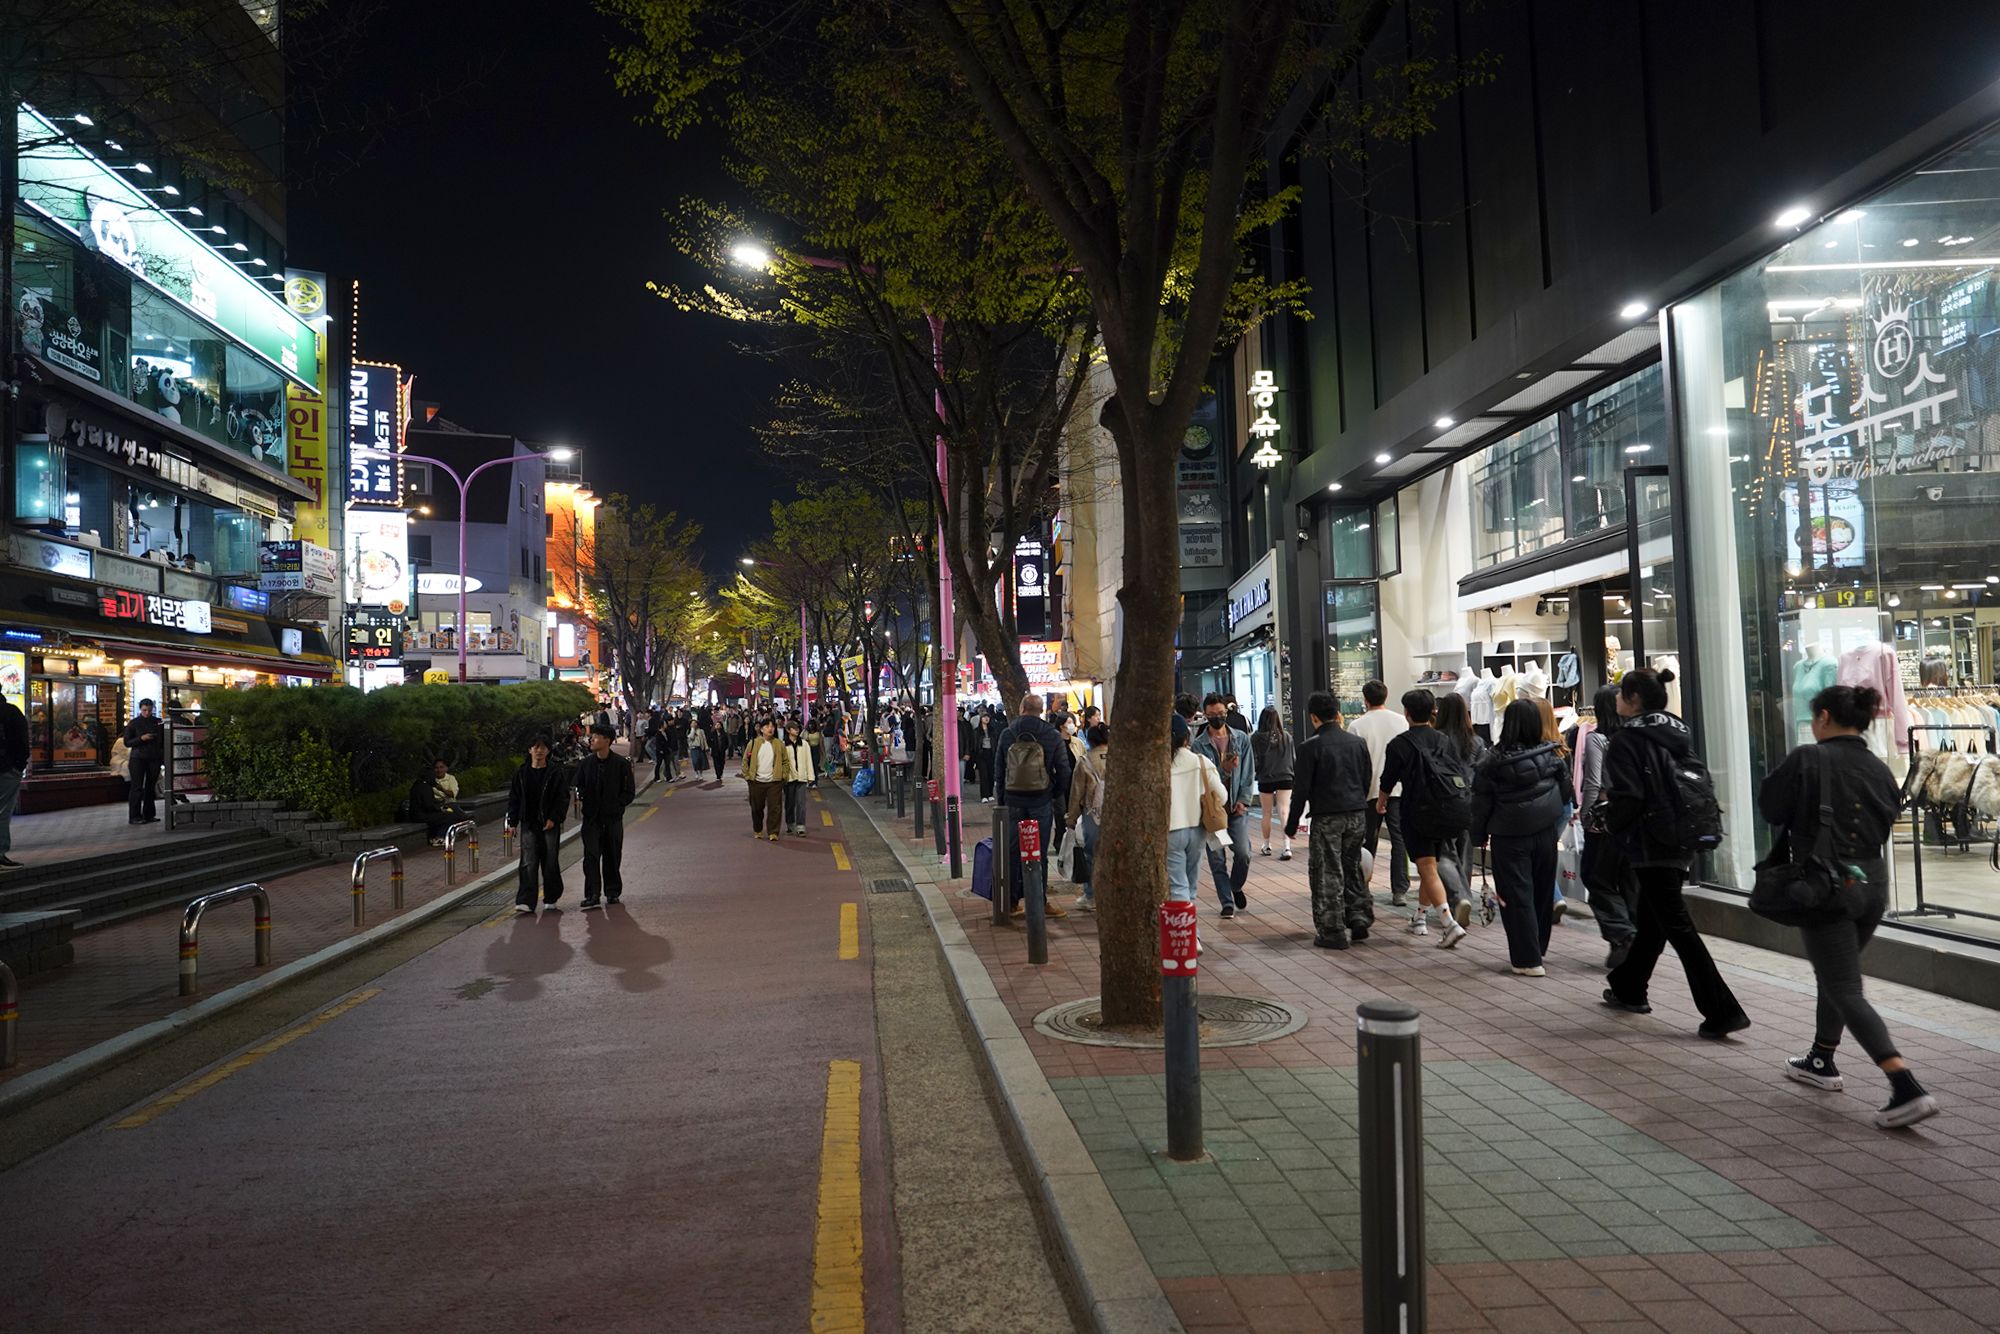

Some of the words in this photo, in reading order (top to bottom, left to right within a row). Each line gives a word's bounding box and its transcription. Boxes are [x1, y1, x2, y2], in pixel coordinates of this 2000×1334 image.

[1249, 371, 1282, 468] 몽슈슈
[1795, 352, 1957, 485] 몽슈슈
[122, 439, 160, 470] 생고기
[374, 465, 391, 492] 카페
[102, 589, 145, 622] 불고기
[147, 595, 187, 629] 전문점
[350, 648, 390, 657] 노연습장
[1024, 665, 1048, 673] OUIS
